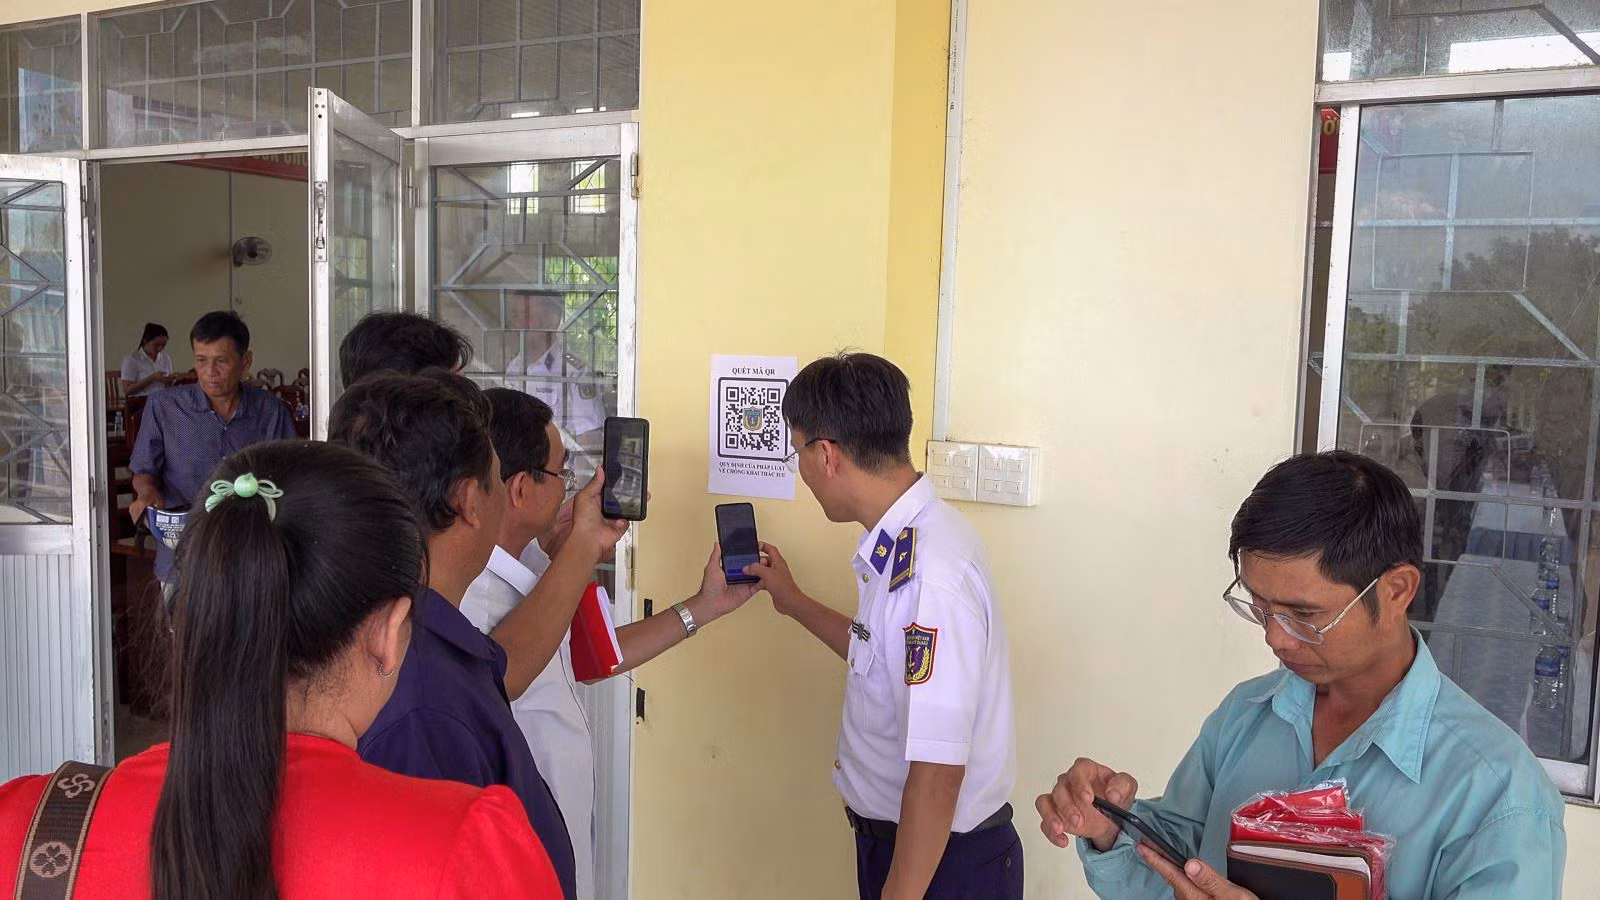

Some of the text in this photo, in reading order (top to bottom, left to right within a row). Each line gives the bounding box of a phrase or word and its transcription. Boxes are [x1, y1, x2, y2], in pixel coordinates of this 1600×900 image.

[732, 365, 776, 376] QUÉT MÃ QR
